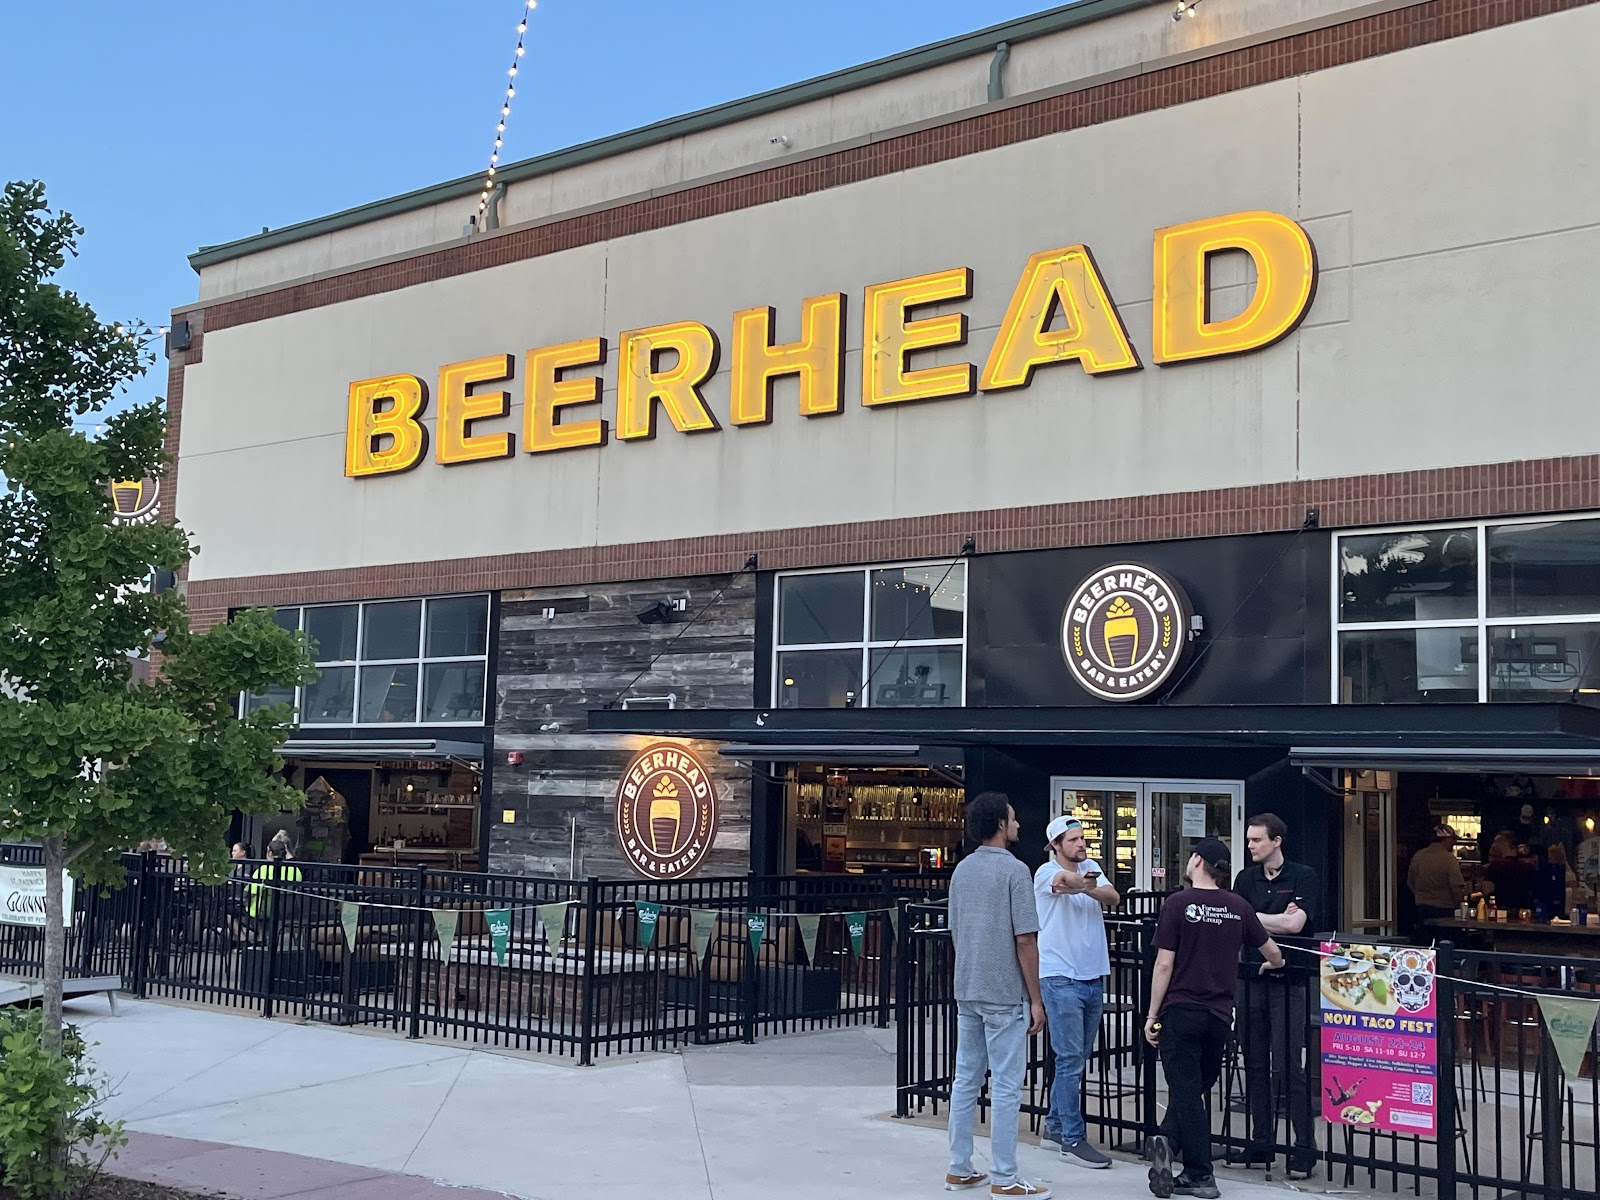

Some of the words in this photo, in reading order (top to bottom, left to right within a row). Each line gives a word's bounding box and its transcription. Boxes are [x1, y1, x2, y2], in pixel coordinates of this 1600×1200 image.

[344, 209, 1319, 478] BEERHEAD
[1072, 572, 1169, 624] BEERHEAD
[1080, 658, 1106, 684] BAR
[1106, 676, 1115, 687] &
[1119, 649, 1166, 688] EATERY
[623, 751, 708, 800] BEERHEAD
[627, 838, 648, 866] BAR
[648, 860, 656, 871] &
[659, 838, 701, 874] EATERY
[6, 891, 46, 913] GUINN
[1201, 904, 1228, 913] Forward
[1201, 910, 1242, 921] Observations
[1202, 916, 1223, 926] Group
[1323, 1012, 1357, 1026] NOVI
[1361, 1015, 1396, 1030] TACO
[1399, 1019, 1434, 1034] FEST
[1334, 1032, 1384, 1046] AUGUST
[1388, 1037, 1426, 1051] 22-24
[1345, 1043, 1361, 1052] 5-10
[1375, 1047, 1395, 1056] 11-10
[1410, 1051, 1426, 1060] 12-7
